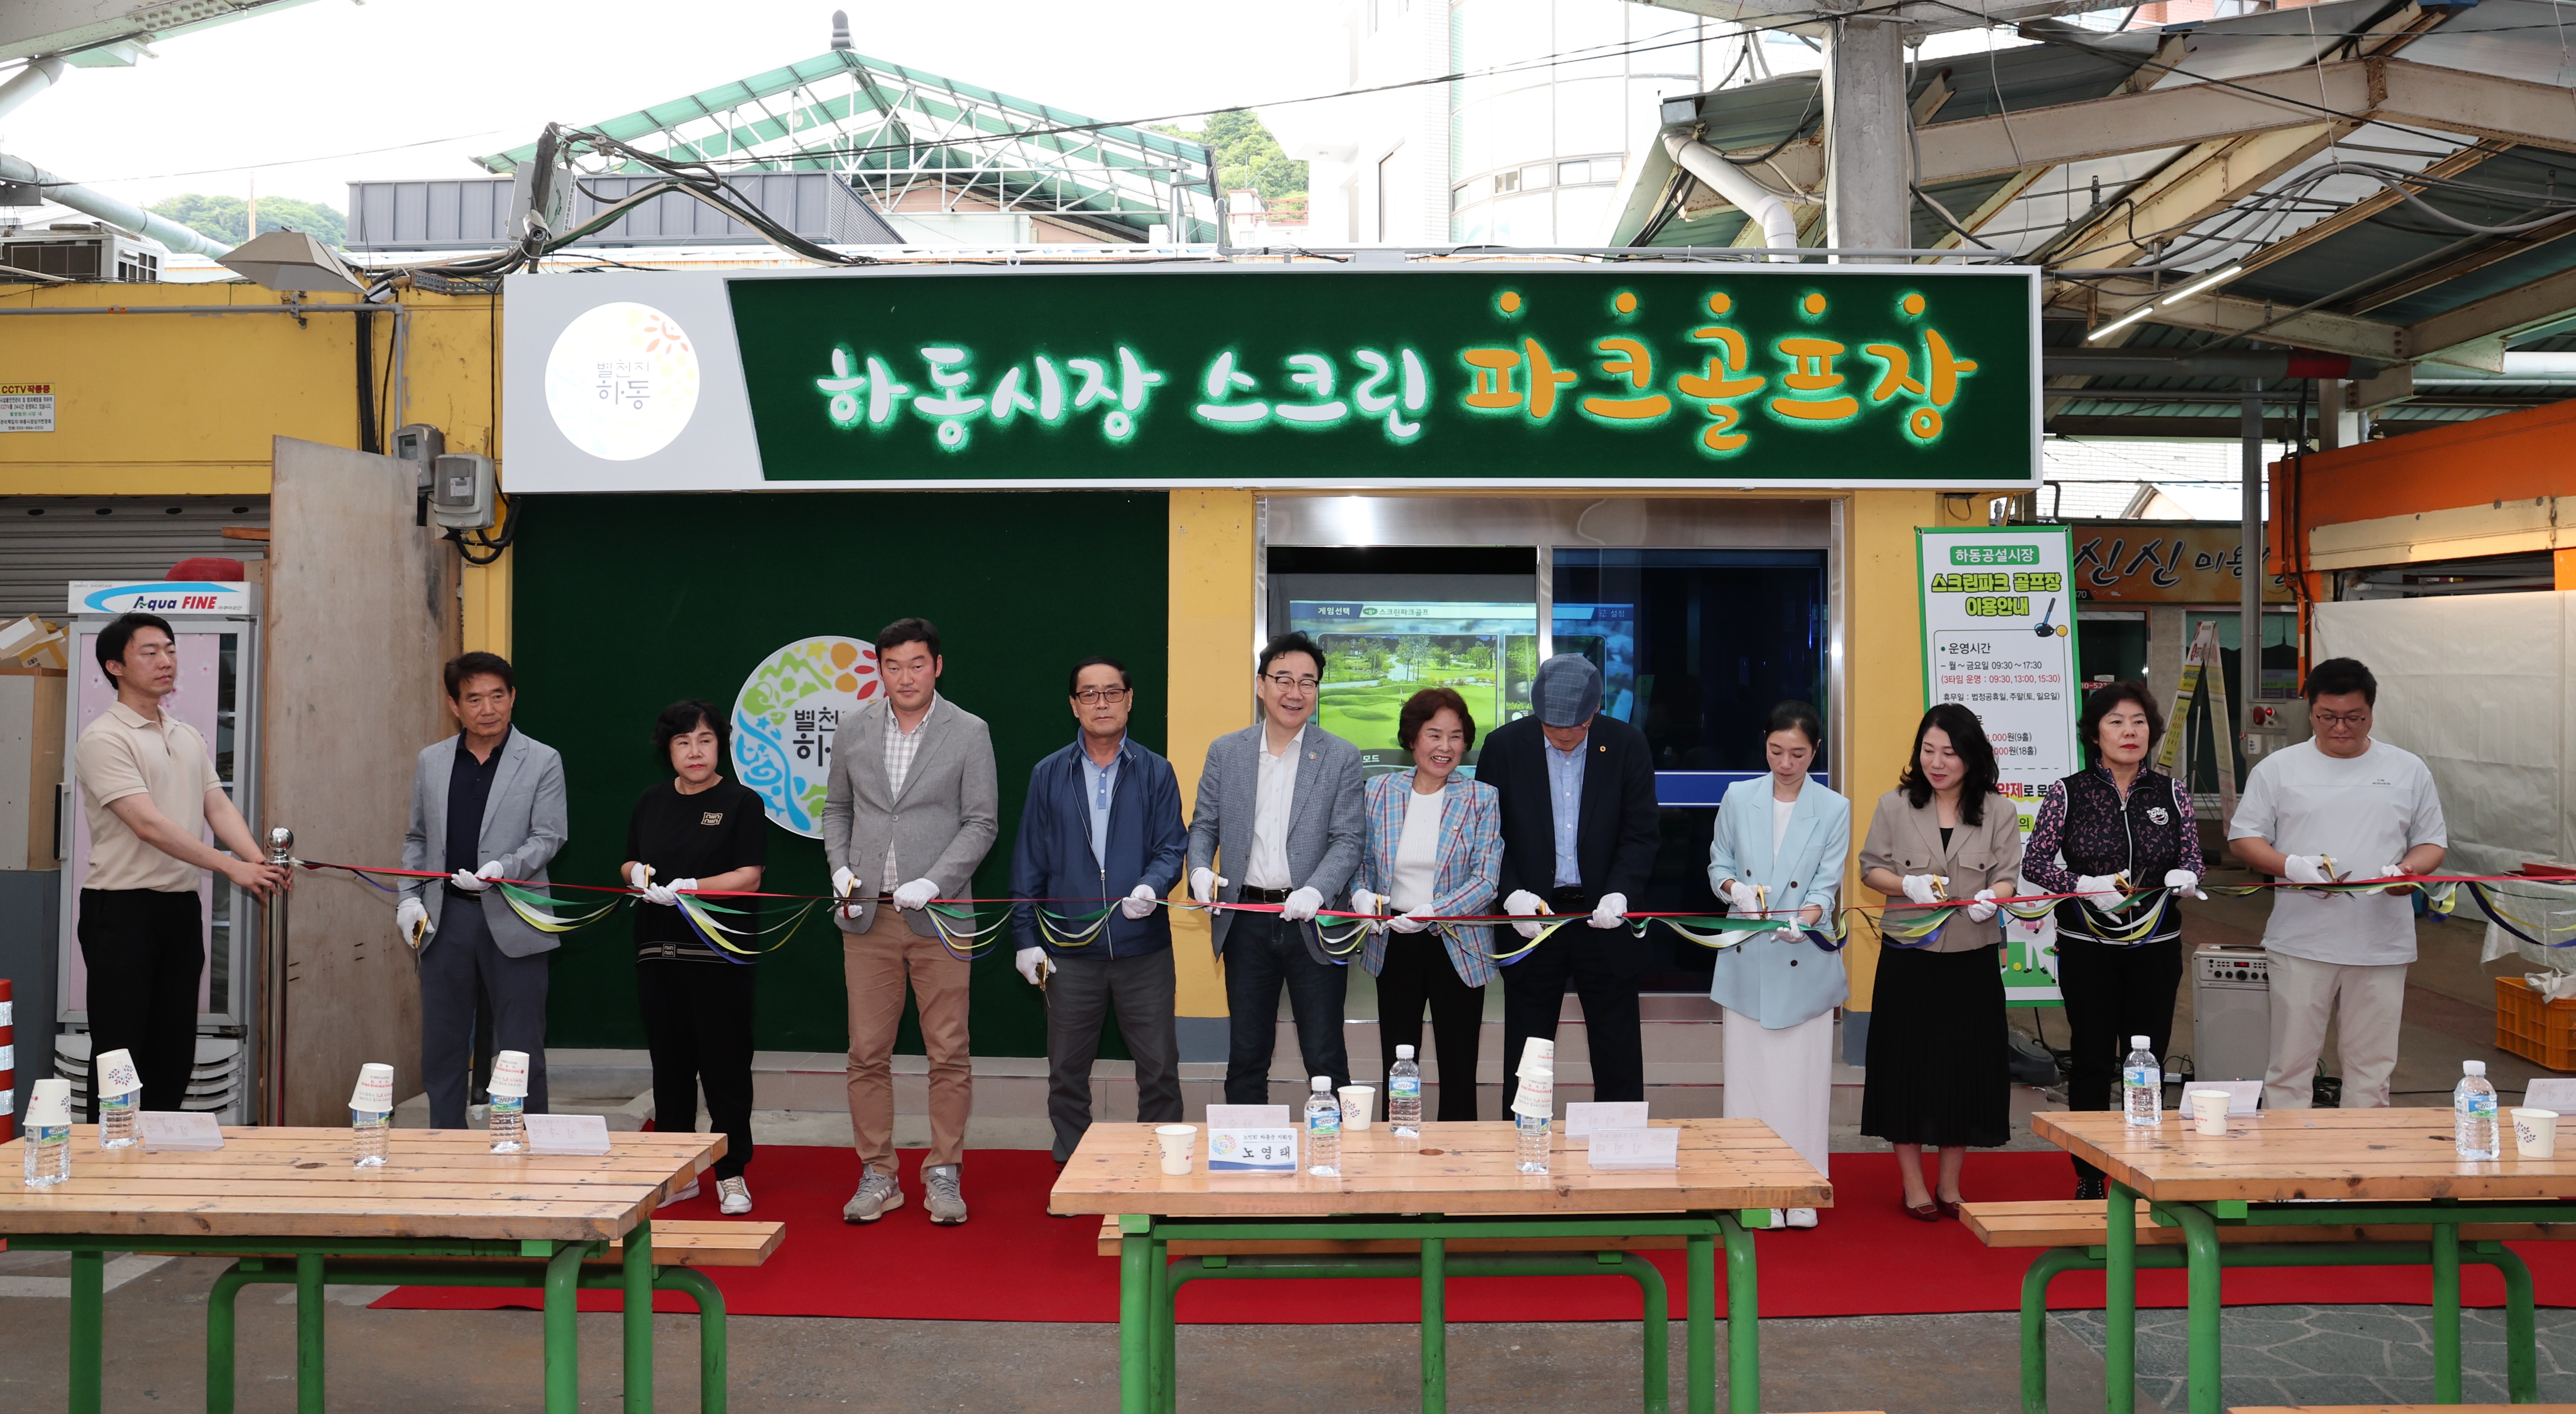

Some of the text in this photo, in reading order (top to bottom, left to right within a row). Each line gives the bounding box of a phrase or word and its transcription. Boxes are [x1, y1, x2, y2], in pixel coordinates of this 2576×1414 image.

[597, 359, 649, 378] 별천지
[817, 291, 1978, 451] 하동시장 스크린 파크골프장
[596, 380, 650, 410] 하동
[1955, 548, 2034, 563] 하동공설시장
[1931, 572, 2062, 593] 스크린파크 골프장
[133, 596, 217, 611] Aqua FINE
[1318, 607, 1350, 616] 게임선택
[1965, 596, 2029, 616] 이용안내
[1948, 643, 1991, 654] 운영시간
[1941, 674, 1963, 684] (3타임
[1966, 675, 1981, 684] 운영
[2038, 674, 2061, 683] 15:30)
[795, 707, 839, 732] 별천
[793, 733, 831, 767] 하
[1995, 783, 2034, 798] 약제로
